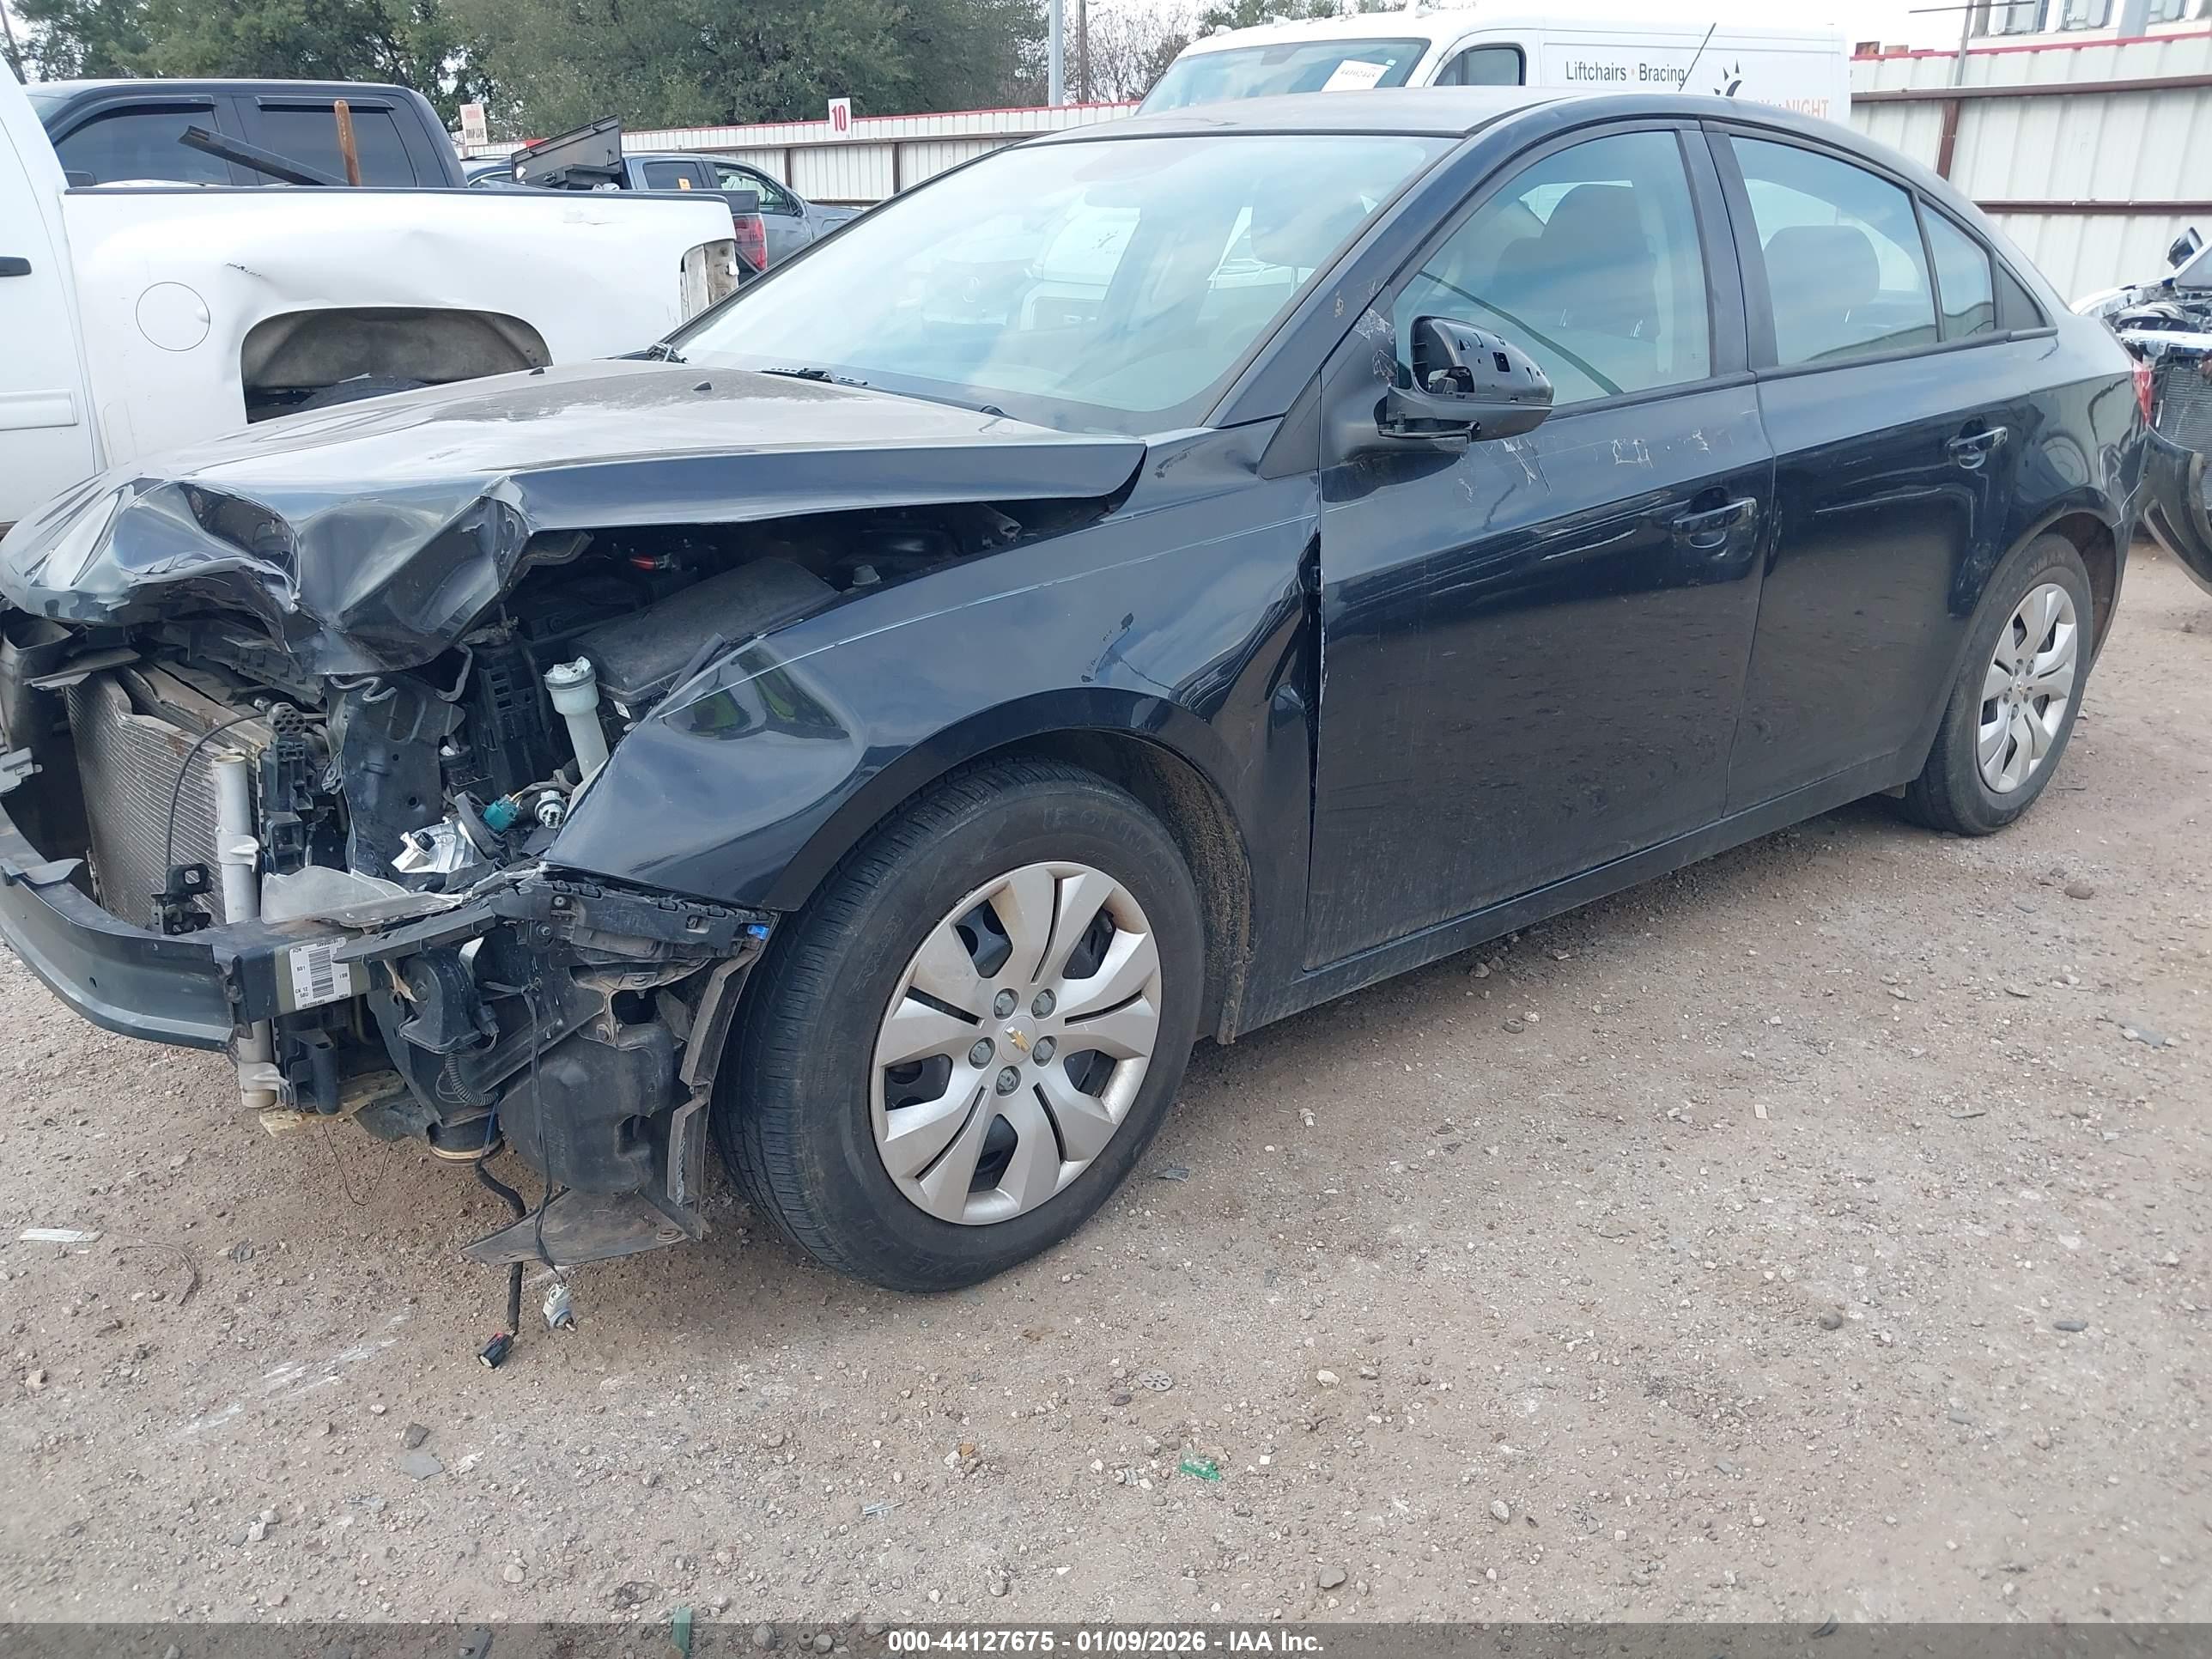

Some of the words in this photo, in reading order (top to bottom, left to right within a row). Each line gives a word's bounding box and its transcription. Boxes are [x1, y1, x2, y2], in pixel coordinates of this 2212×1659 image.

[1565, 60, 1627, 82] Liftchairs
[1639, 63, 1686, 87] Bracing
[831, 104, 847, 131] 10
[1785, 99, 1829, 119] NIGHT
